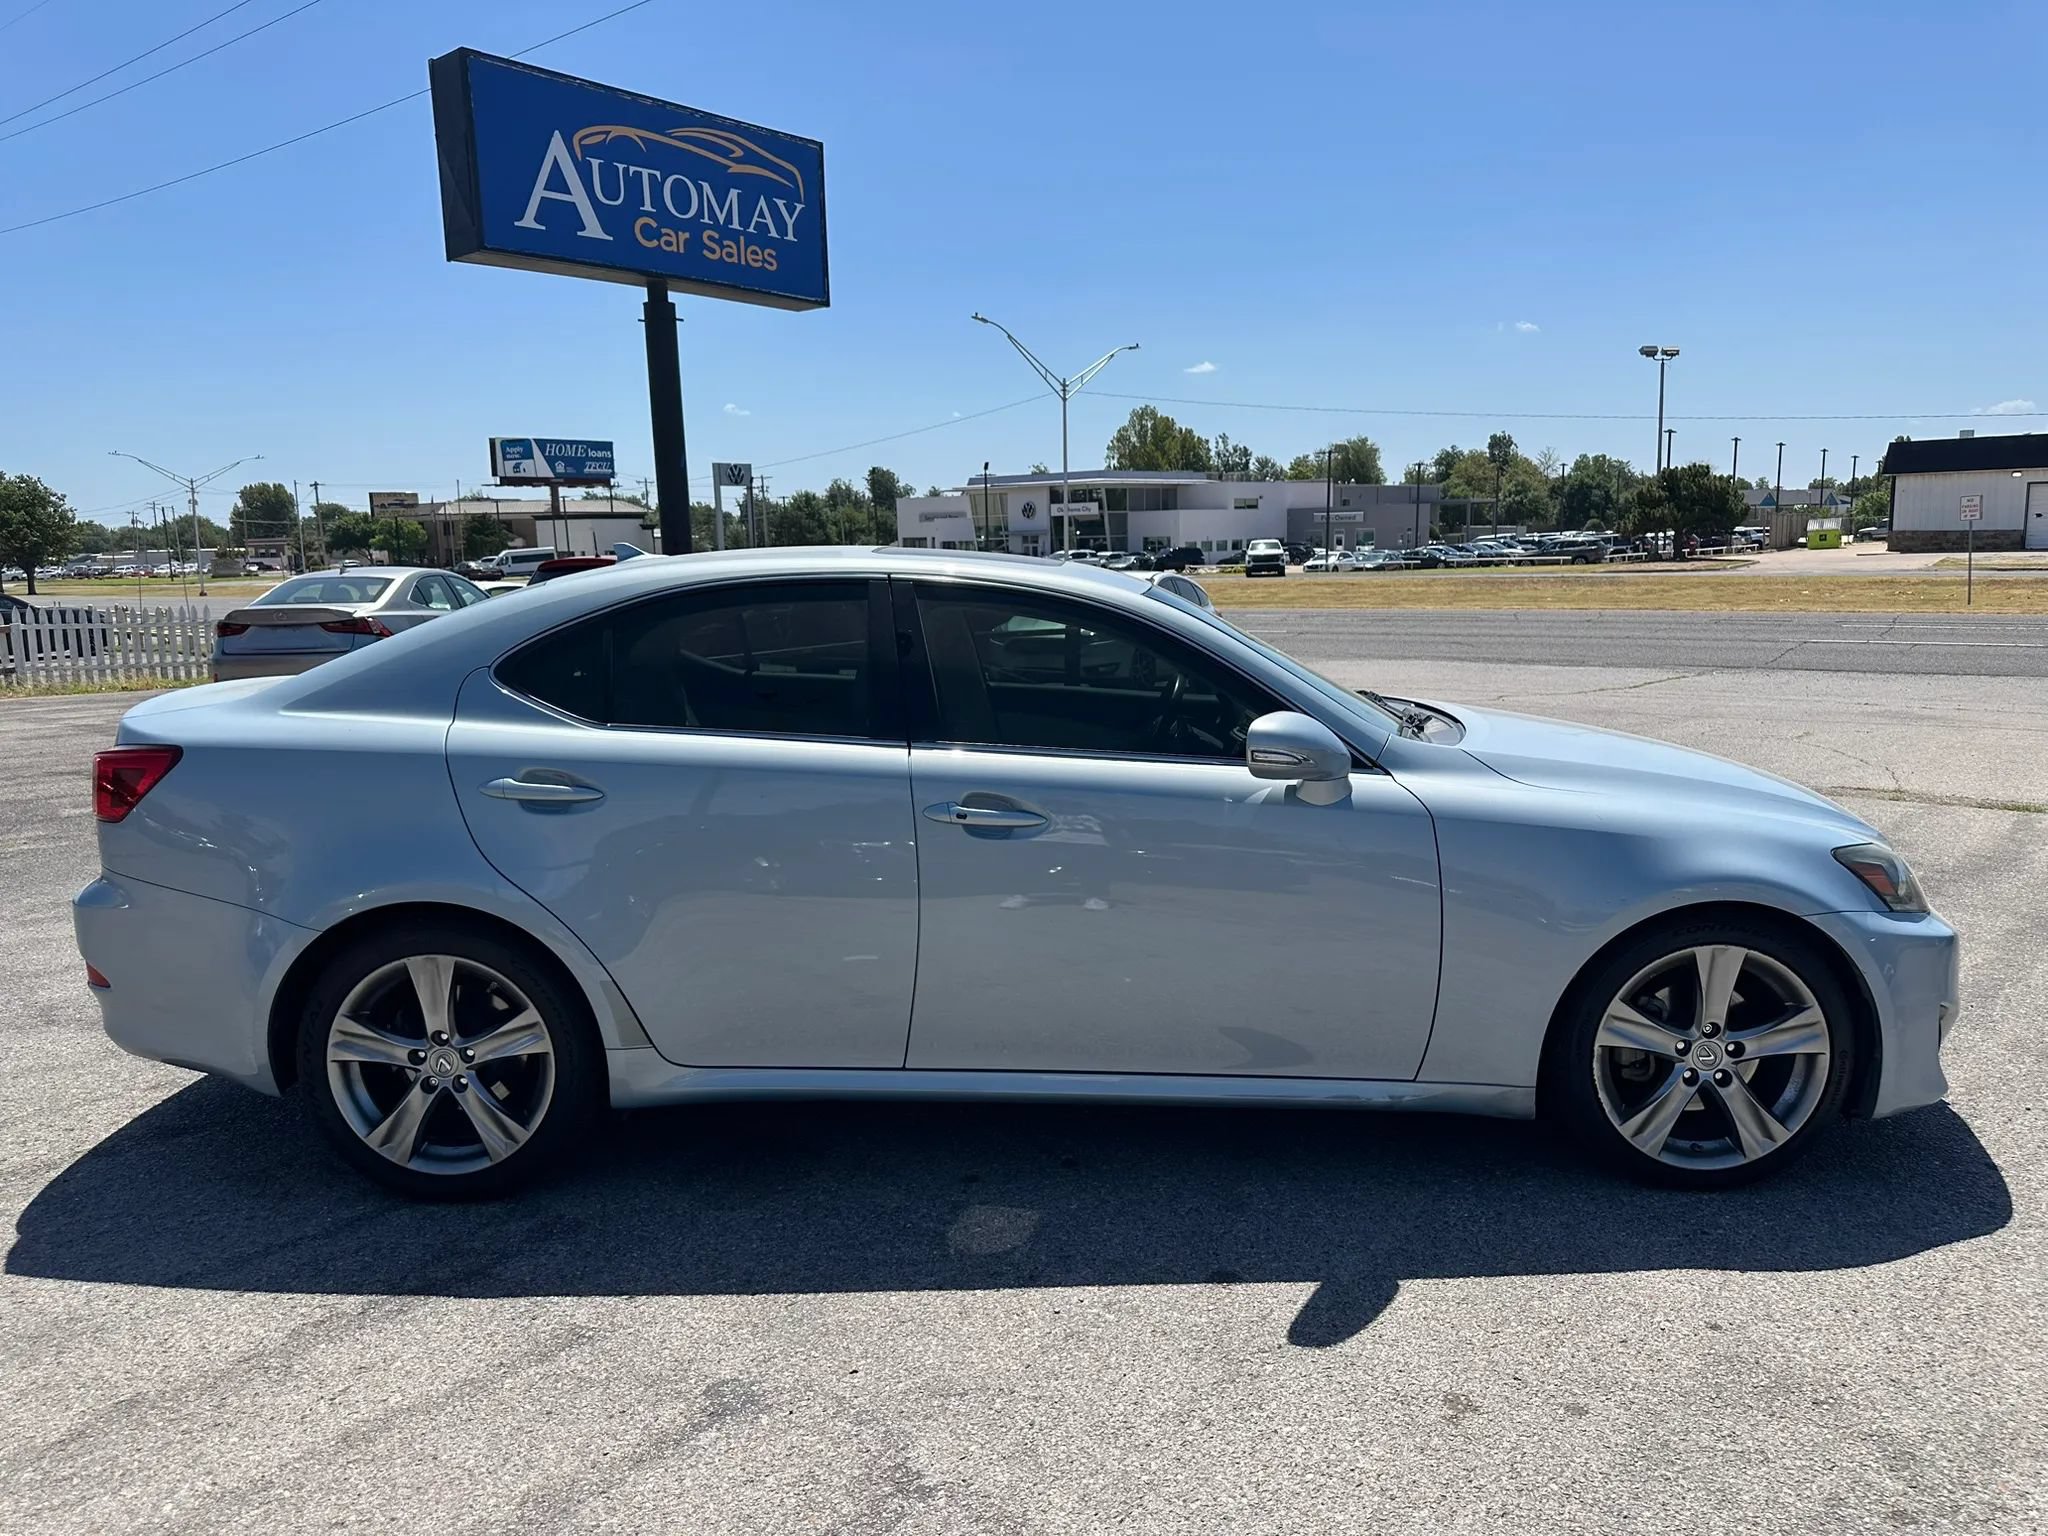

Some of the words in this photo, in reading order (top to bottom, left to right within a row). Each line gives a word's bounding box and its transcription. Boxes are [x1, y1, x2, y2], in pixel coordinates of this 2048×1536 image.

[514, 130, 805, 242] AUTOMAY
[633, 216, 690, 254] Car
[702, 230, 779, 272] Sales
[545, 443, 587, 457] HOME
[588, 448, 612, 458] loans
